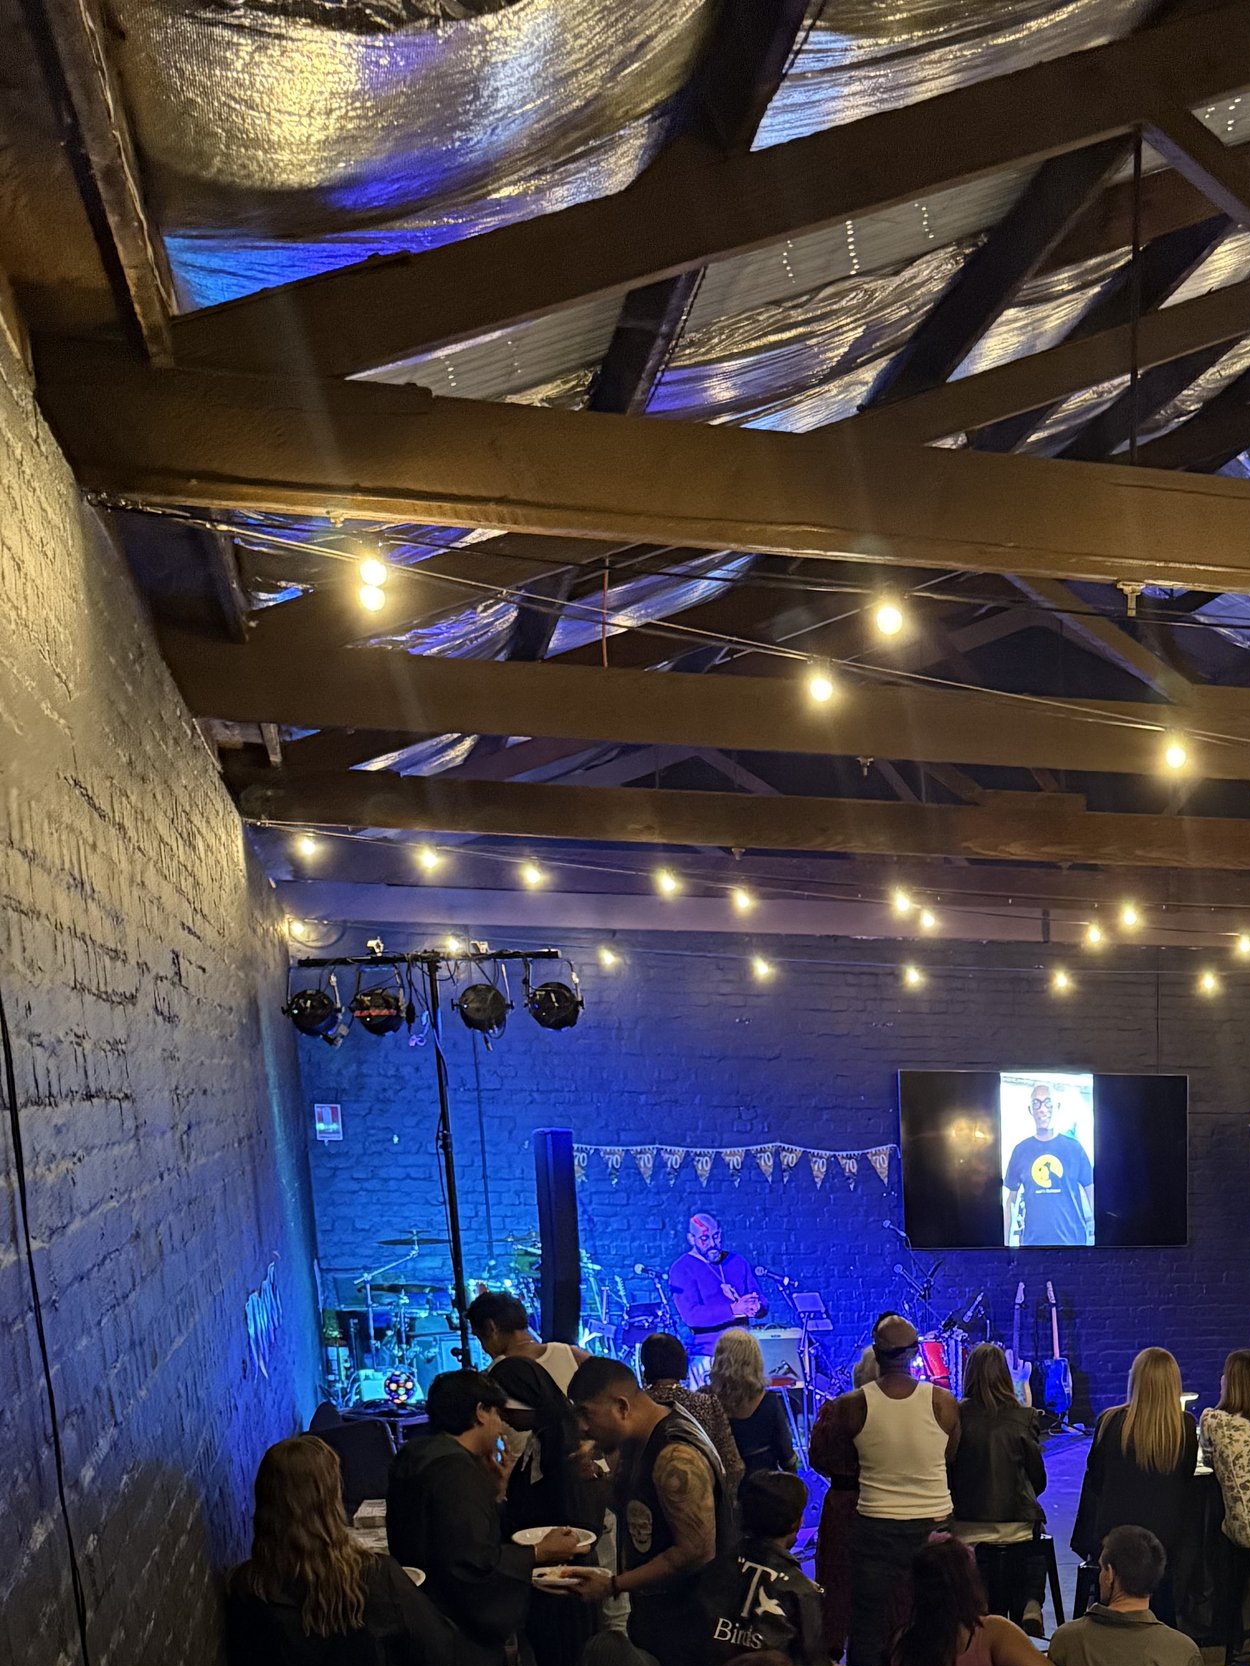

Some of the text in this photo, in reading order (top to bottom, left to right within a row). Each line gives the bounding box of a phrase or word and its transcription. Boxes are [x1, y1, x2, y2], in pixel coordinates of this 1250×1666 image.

[574, 1152, 588, 1166] 70
[607, 1154, 621, 1168] 70
[637, 1153, 651, 1167] 70
[667, 1154, 681, 1168] 70
[696, 1156, 710, 1170] 70
[729, 1156, 742, 1169] 70
[758, 1152, 773, 1166] 70
[783, 1152, 796, 1167] 70
[813, 1158, 827, 1172] 70
[844, 1158, 858, 1172] 70
[873, 1154, 888, 1168] 70
[713, 1617, 763, 1649] Birds
